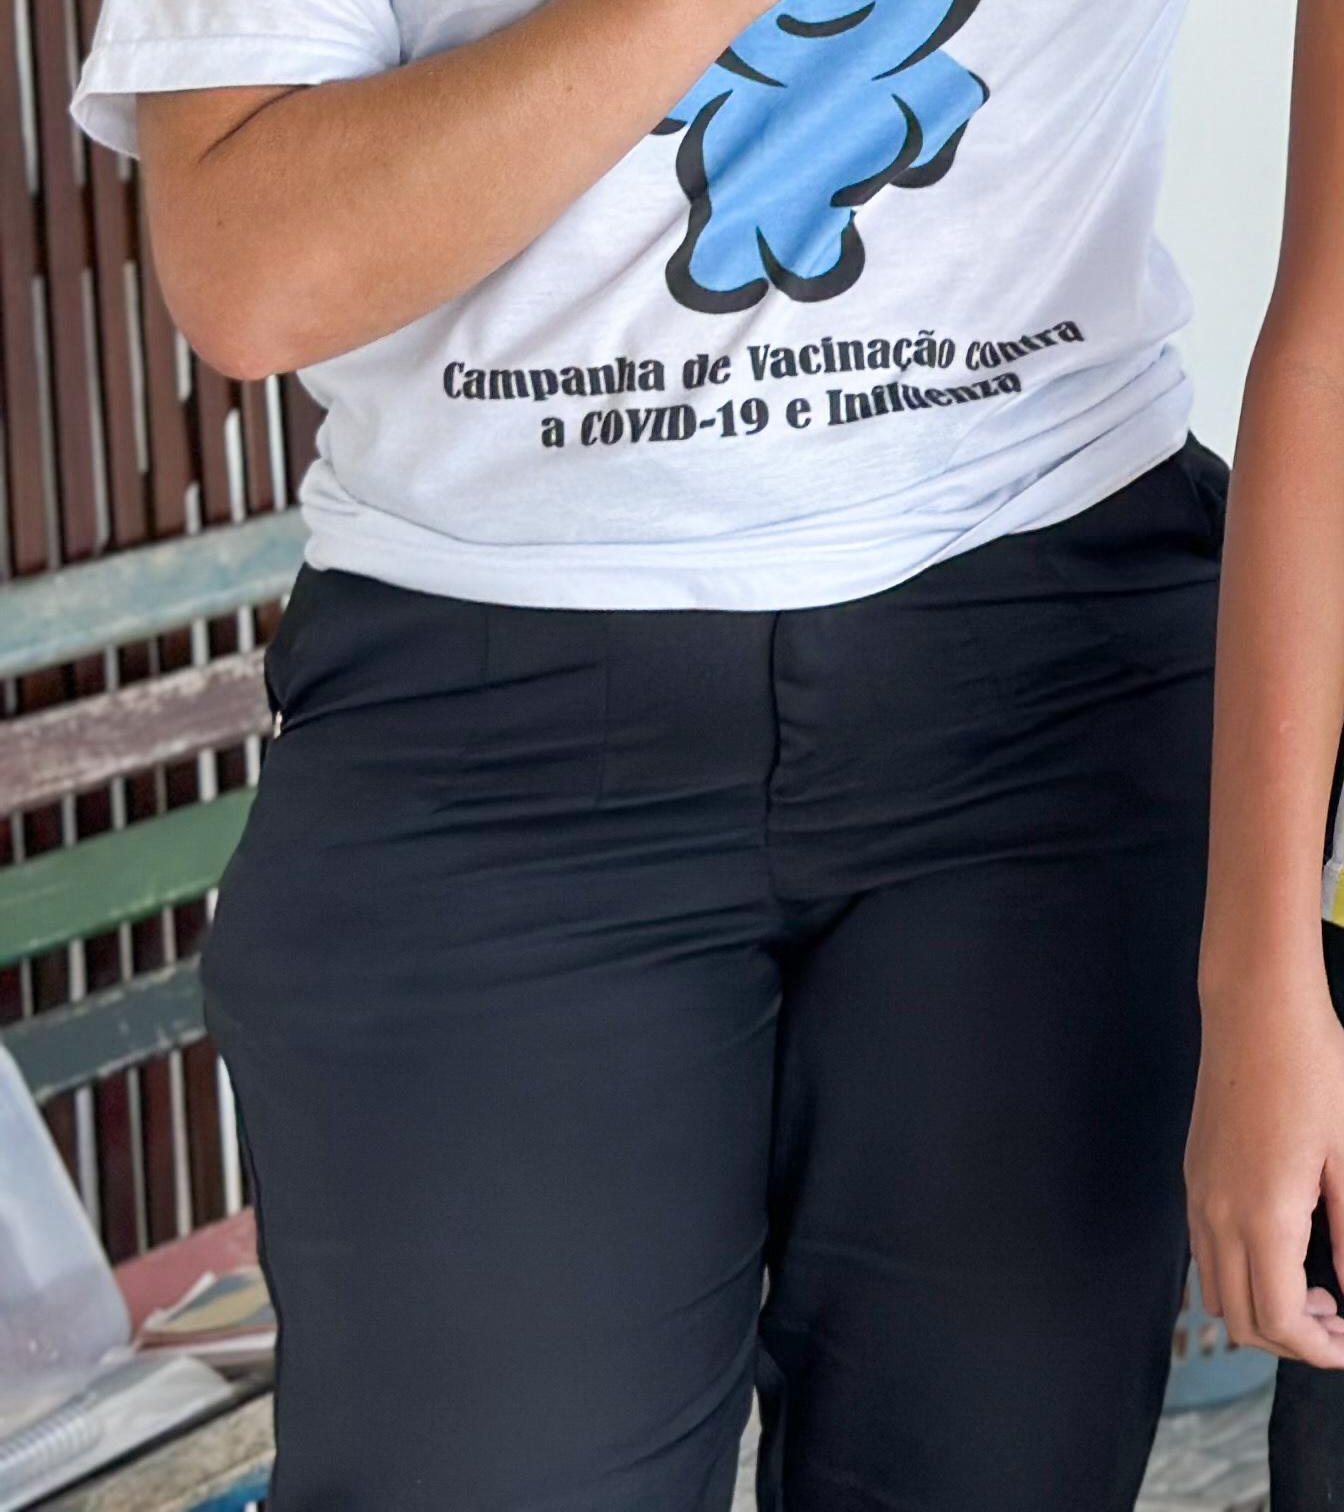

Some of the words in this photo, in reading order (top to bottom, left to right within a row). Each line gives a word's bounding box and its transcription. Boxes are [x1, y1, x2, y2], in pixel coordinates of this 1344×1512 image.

[443, 356, 665, 401] Campanha
[682, 353, 731, 389] de
[747, 330, 955, 380] Vacinação
[965, 320, 1084, 371] contra
[541, 416, 565, 448] a
[581, 397, 769, 446] COVID-19
[786, 396, 811, 428] e
[826, 372, 1022, 426] Influenza
